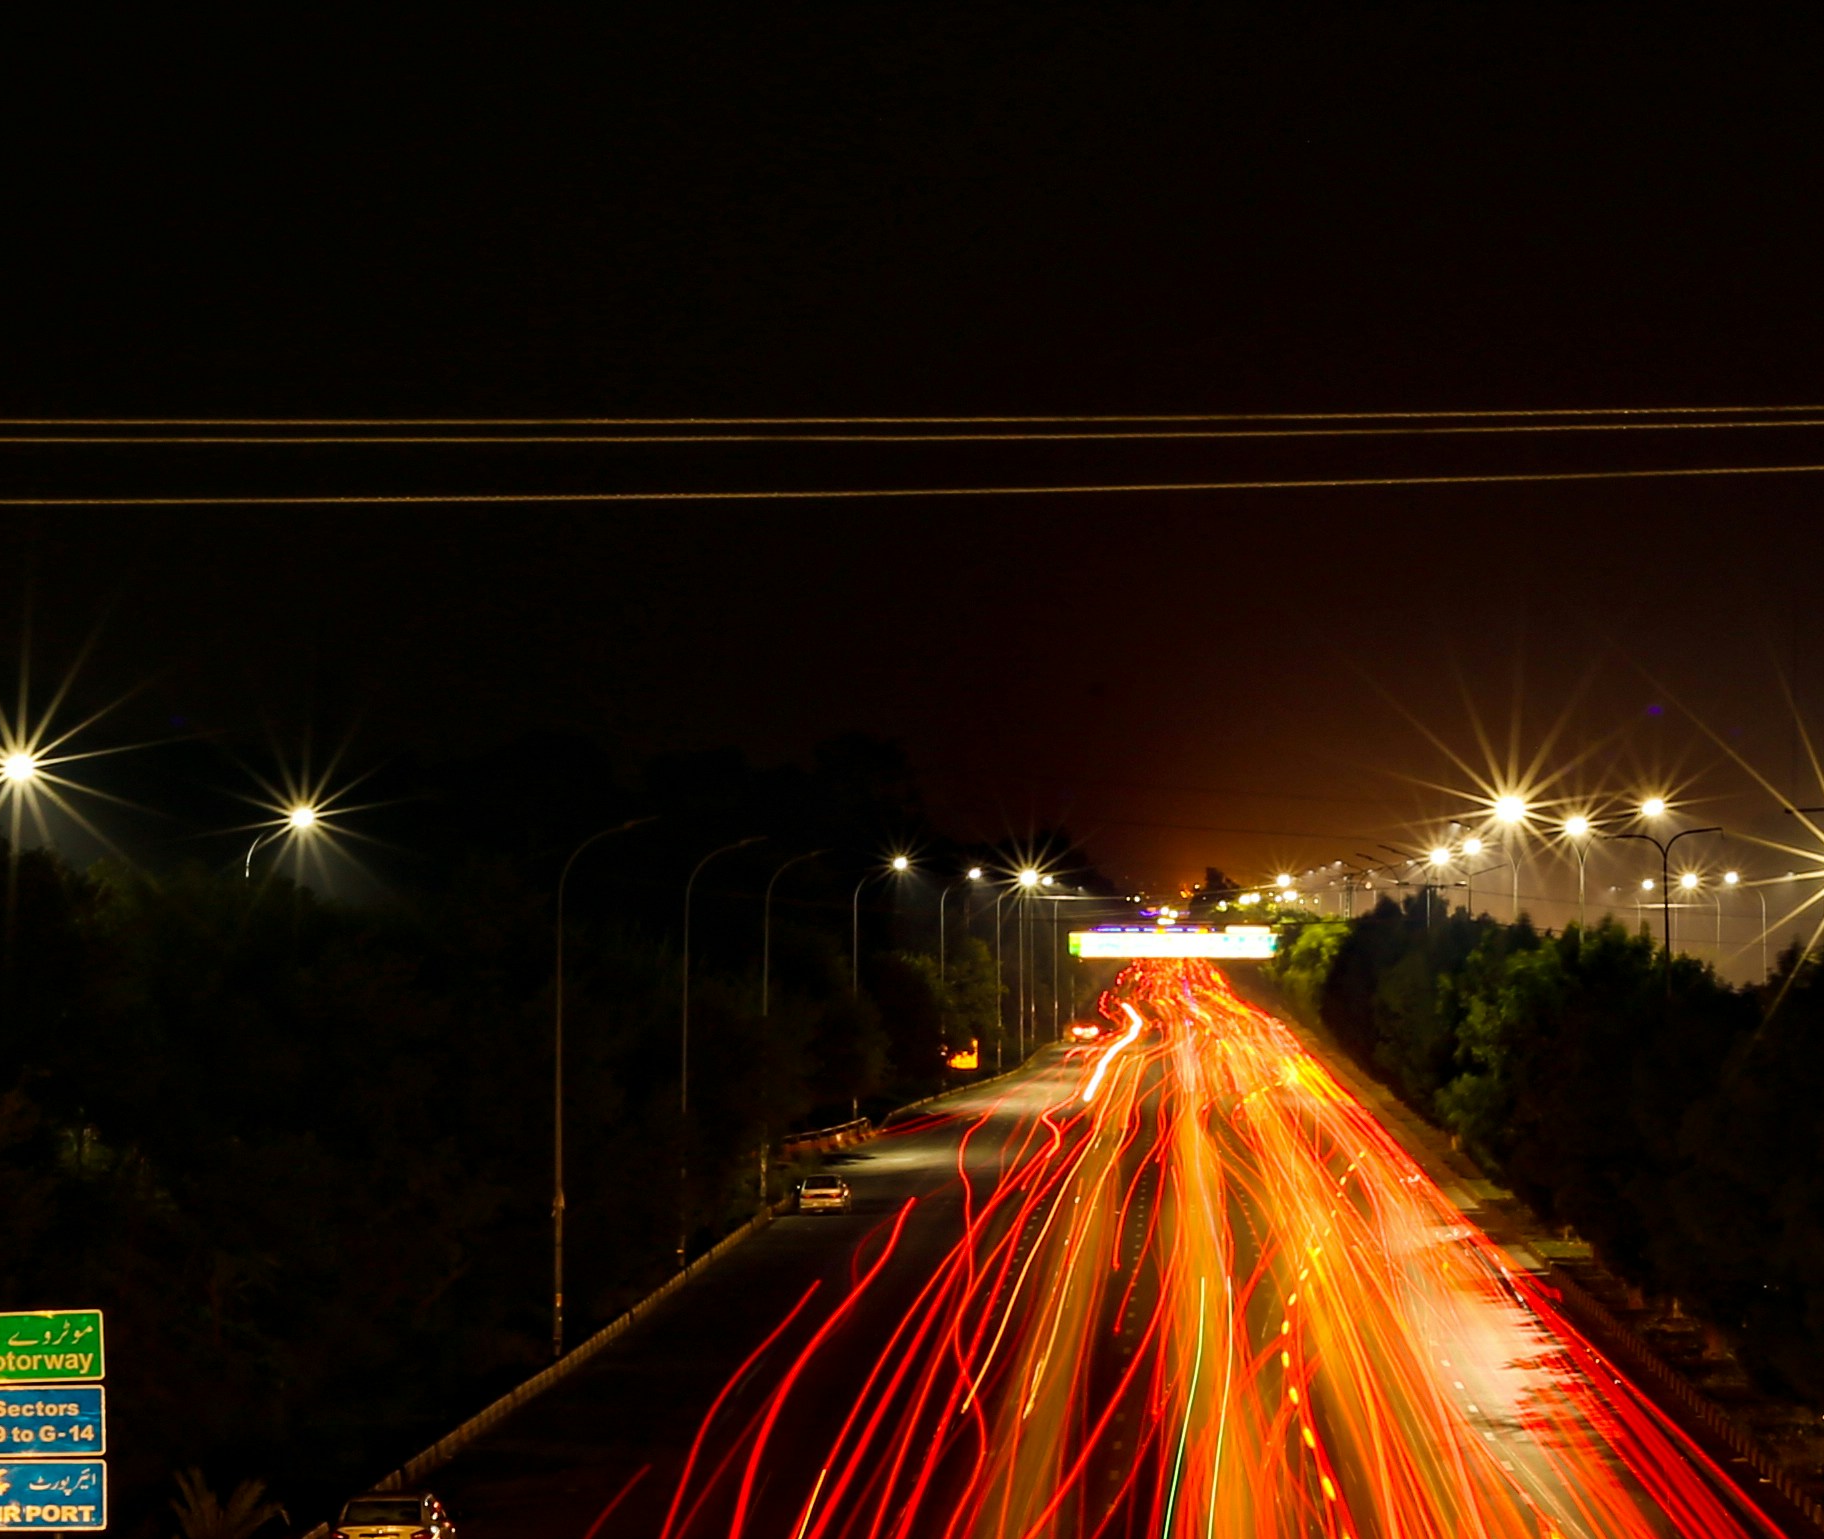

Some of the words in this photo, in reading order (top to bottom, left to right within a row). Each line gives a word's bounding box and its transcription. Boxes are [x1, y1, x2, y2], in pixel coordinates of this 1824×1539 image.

[7, 1319, 94, 1347] موٹروے
[11, 1427, 35, 1442] to
[39, 1425, 95, 1442] G-14
